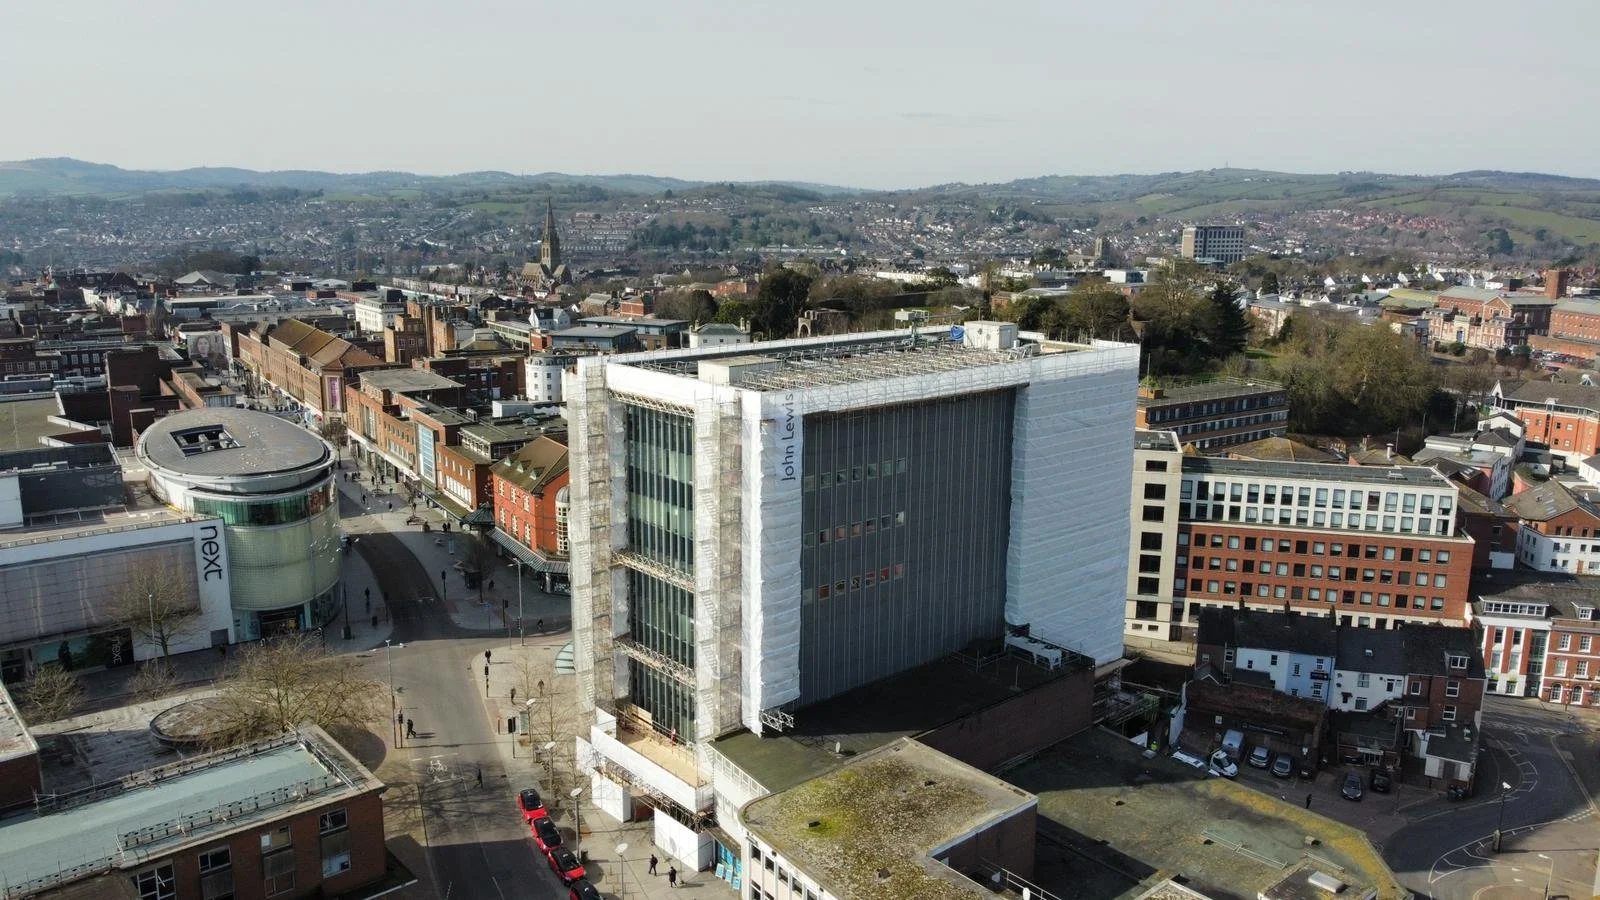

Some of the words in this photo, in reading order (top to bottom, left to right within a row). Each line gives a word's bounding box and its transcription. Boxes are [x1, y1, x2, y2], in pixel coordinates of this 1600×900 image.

[781, 393, 795, 441] Lewis
[781, 445, 796, 481] John
[200, 525, 223, 582] next
